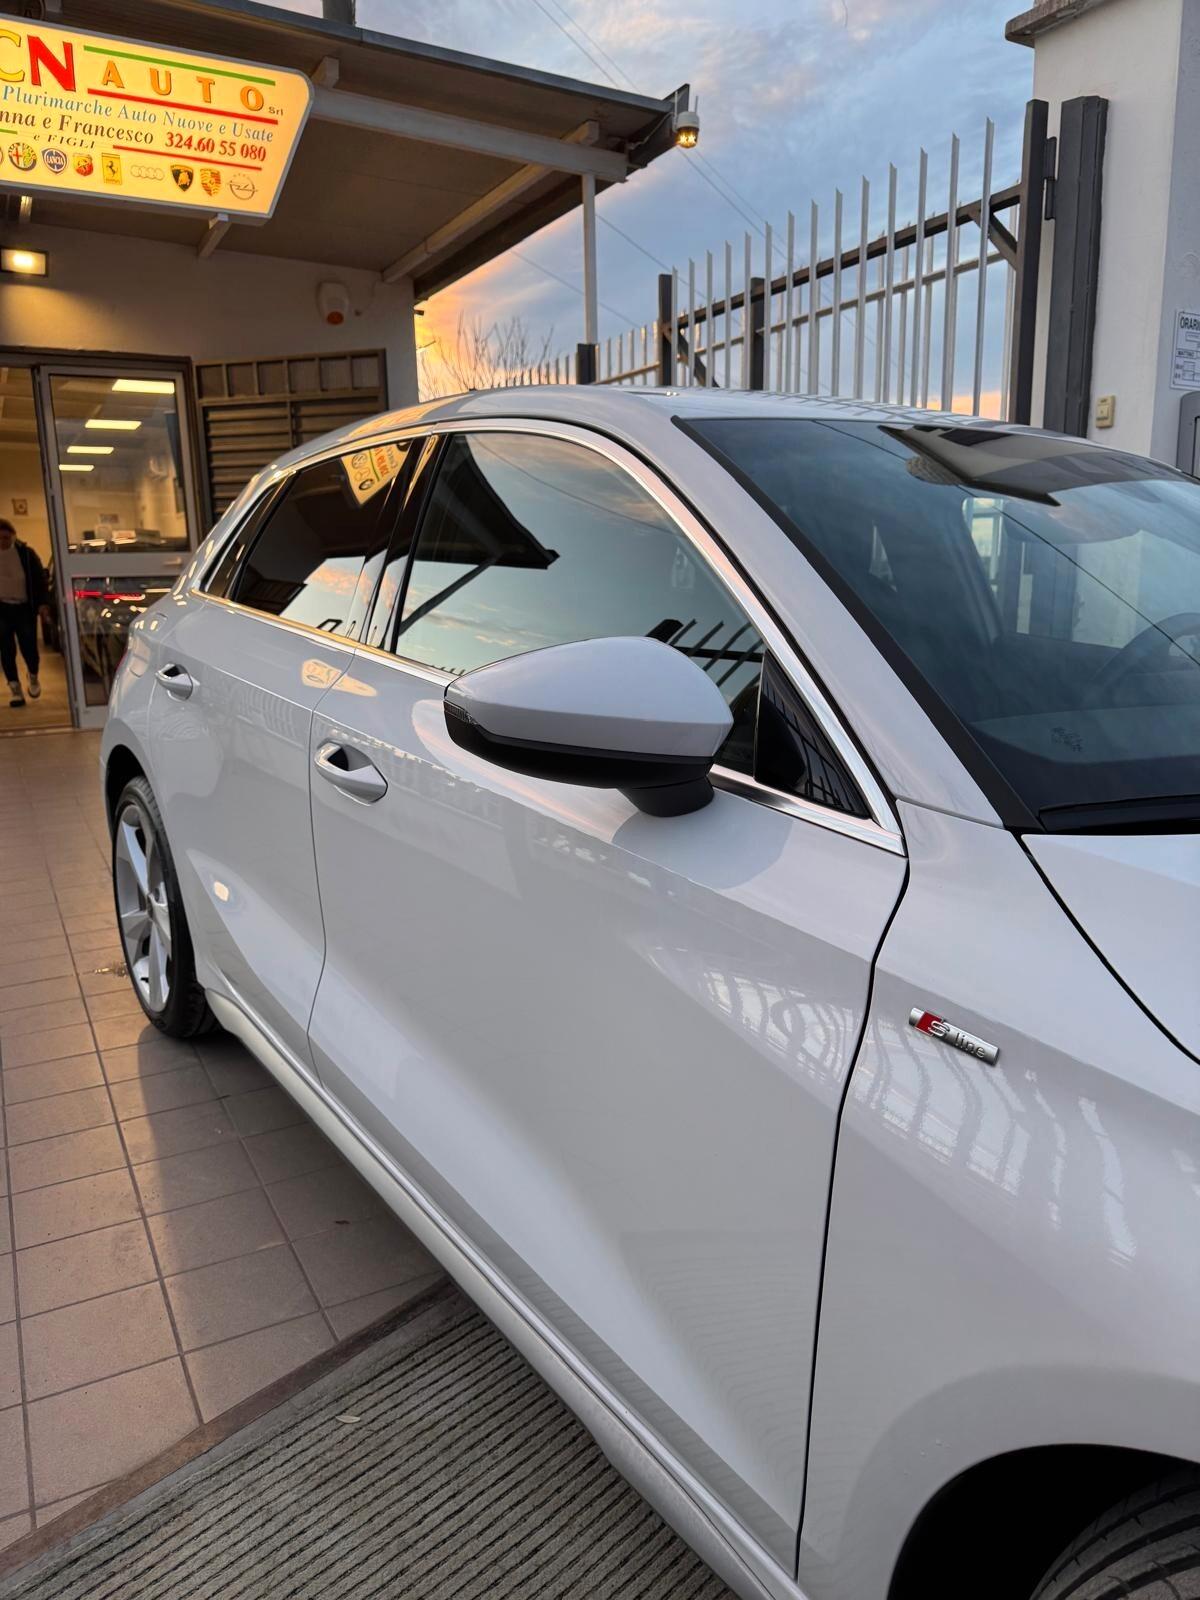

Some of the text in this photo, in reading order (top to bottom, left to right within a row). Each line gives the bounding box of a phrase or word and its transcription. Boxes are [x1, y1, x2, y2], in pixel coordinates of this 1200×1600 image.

[0, 28, 284, 117] CN AUTO Srl
[3, 85, 273, 142] Plurimarche Auto Nuove e Usate
[42, 116, 52, 129] e
[58, 114, 154, 145] Francesco
[48, 134, 95, 149] FIGLI
[165, 132, 266, 162] 324.60 55 080
[928, 1020, 986, 1058] S line
